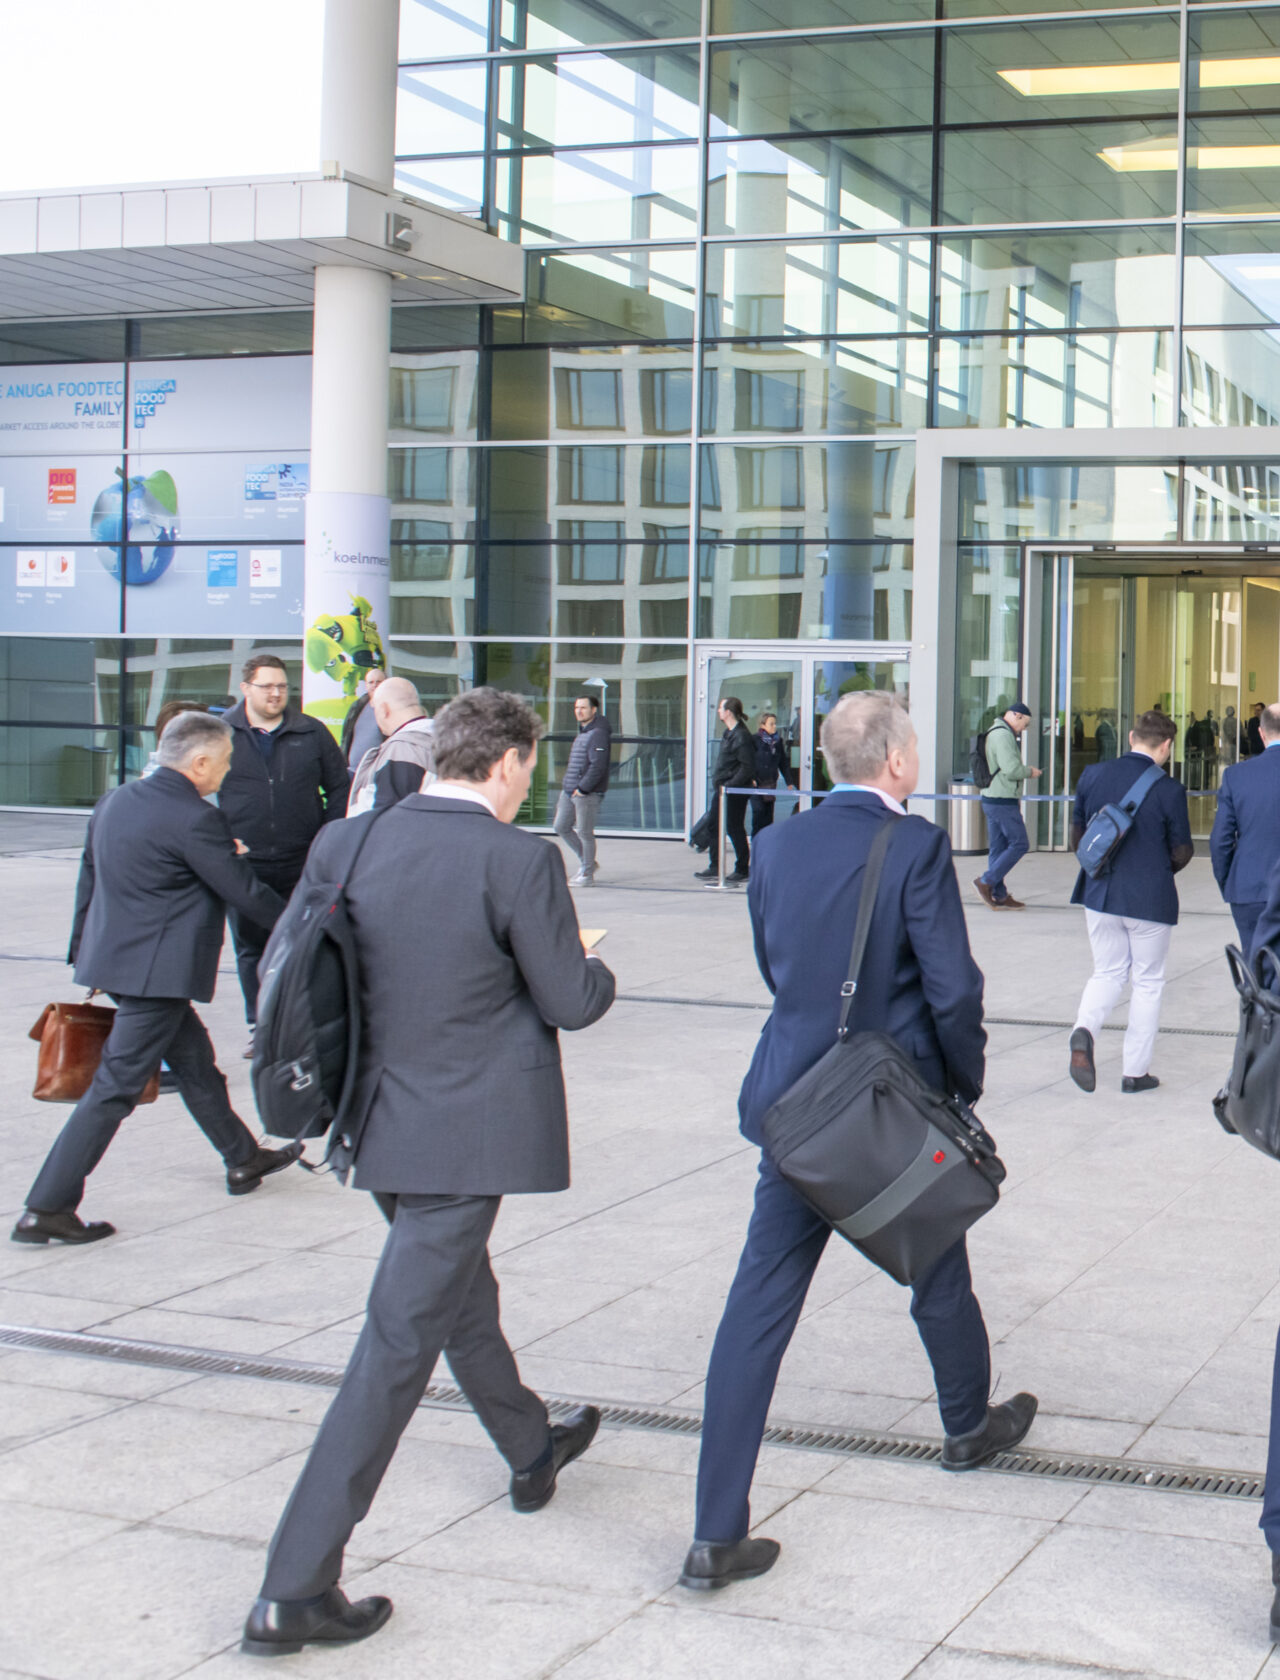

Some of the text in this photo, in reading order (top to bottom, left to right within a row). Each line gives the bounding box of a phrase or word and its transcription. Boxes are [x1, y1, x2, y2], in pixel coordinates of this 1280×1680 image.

[6, 383, 54, 398] ANUGA
[58, 381, 123, 397] FOODTEC
[136, 393, 165, 404] FOOD
[75, 401, 124, 416] FAMILY
[136, 406, 155, 415] TEC
[0, 423, 21, 431] ARKET
[49, 421, 79, 430] AROUND
[80, 421, 94, 429] THE
[49, 472, 74, 487] pro
